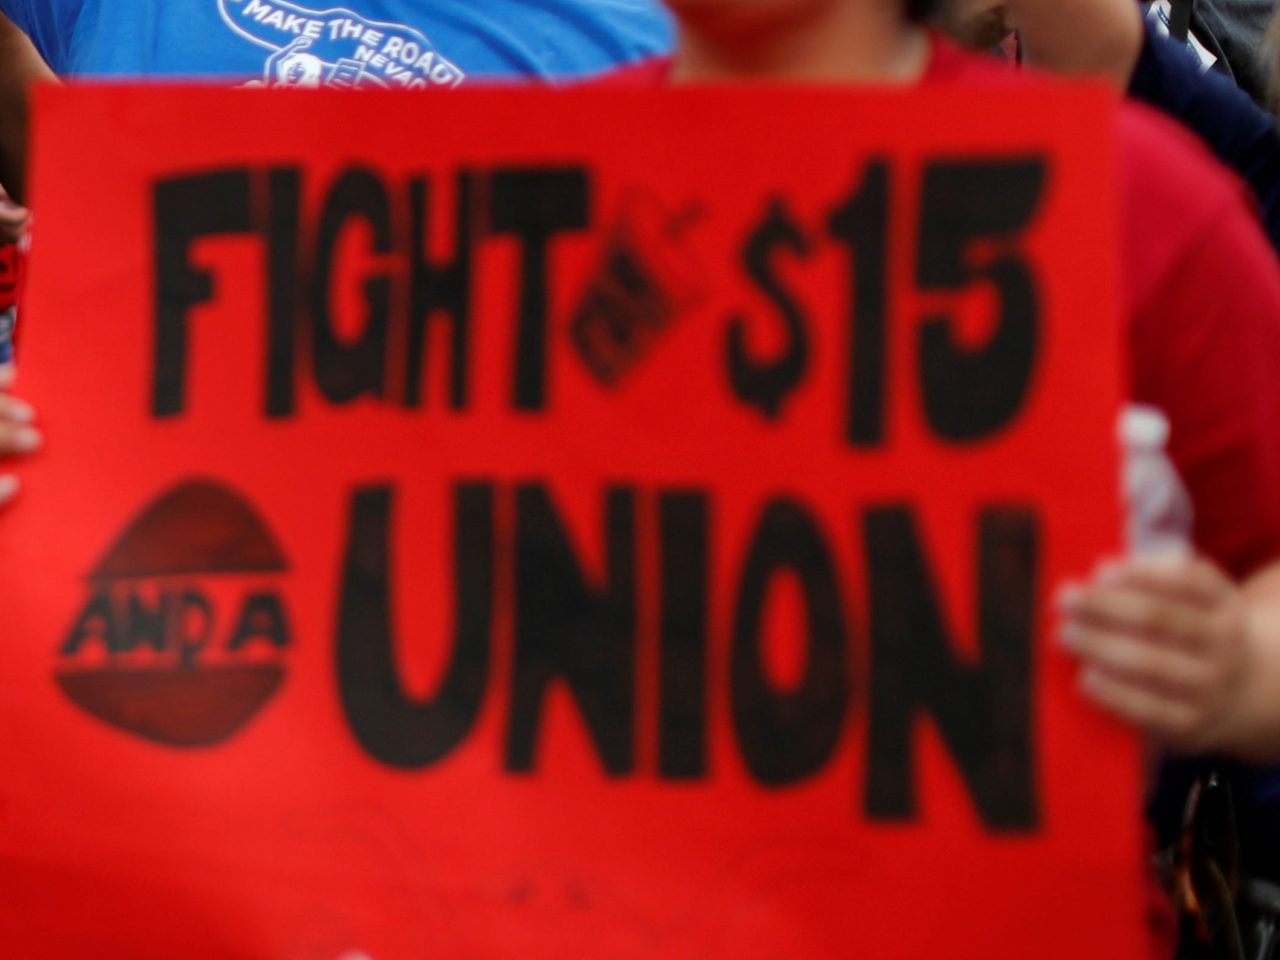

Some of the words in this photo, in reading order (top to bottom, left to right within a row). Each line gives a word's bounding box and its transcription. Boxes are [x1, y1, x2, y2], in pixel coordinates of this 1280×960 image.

[327, 18, 383, 46] THE
[381, 36, 454, 85] ROAD
[150, 162, 593, 420] FIGHT
[724, 150, 1052, 452] $15
[335, 477, 1045, 835] UNION
